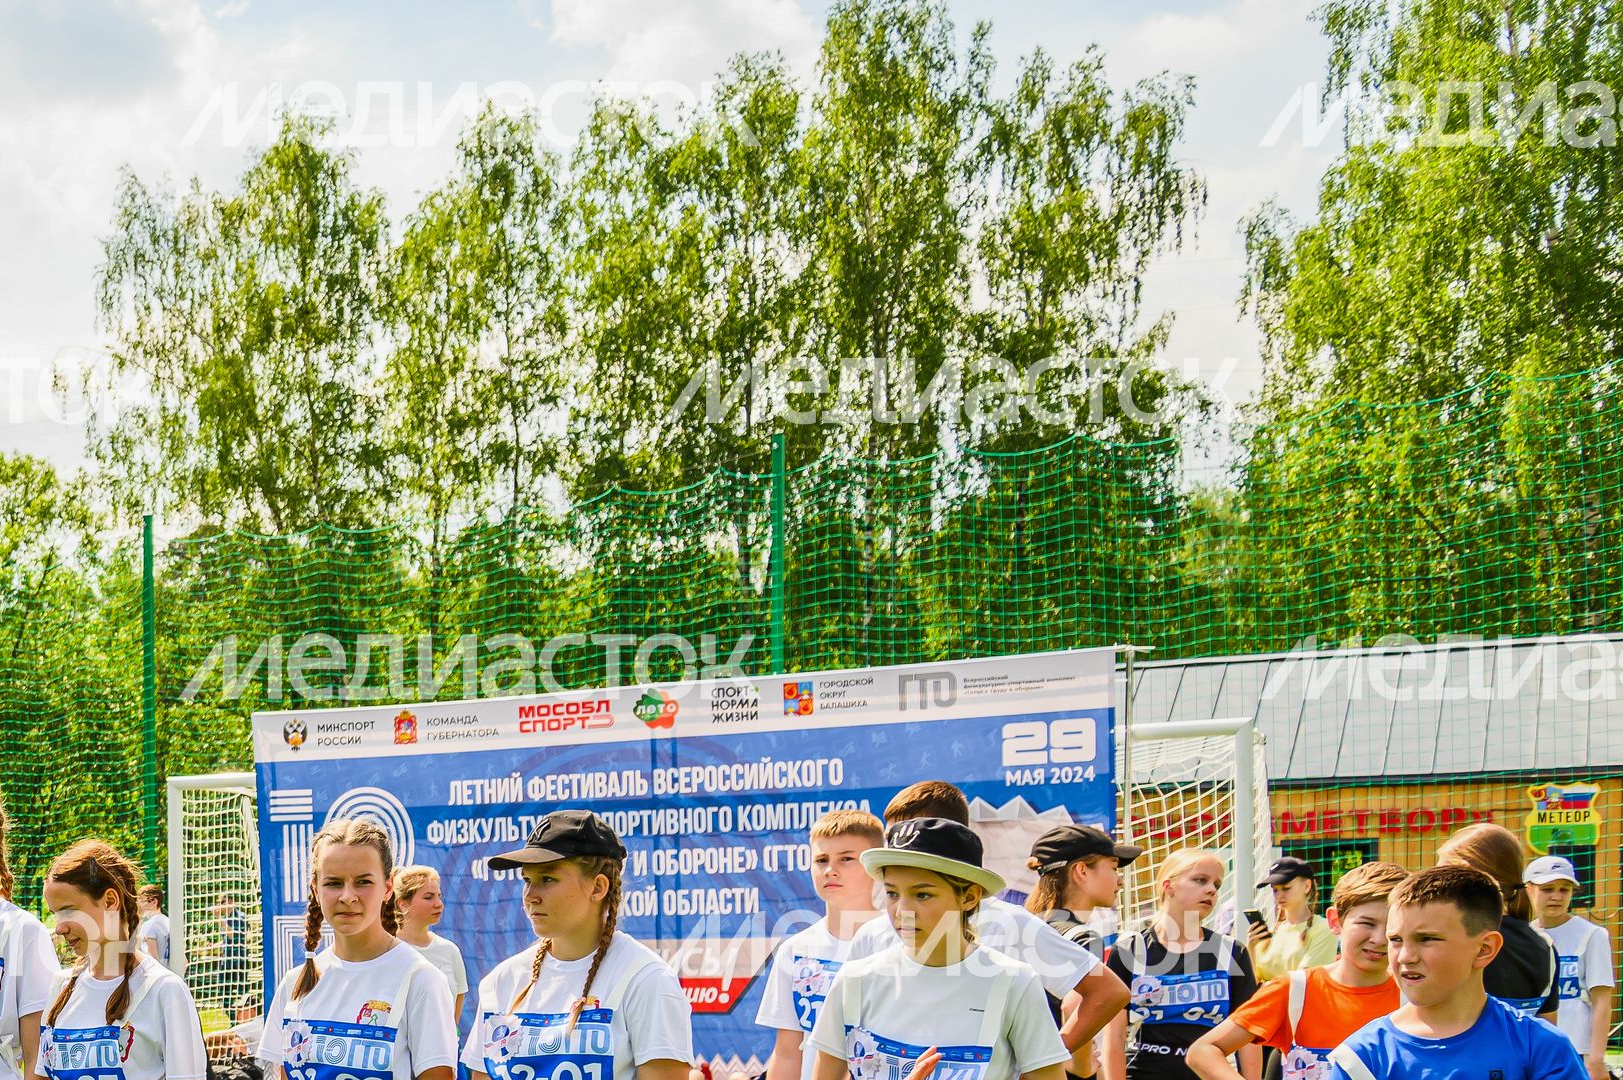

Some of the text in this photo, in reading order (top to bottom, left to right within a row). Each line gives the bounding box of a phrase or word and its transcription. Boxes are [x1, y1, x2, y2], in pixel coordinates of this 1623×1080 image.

[819, 676, 874, 689] ГОРОДСКОЙ
[819, 689, 847, 699] ОКРУГ
[712, 699, 758, 711] НОРМА
[819, 699, 868, 710] БАЛАШИХА
[427, 715, 479, 727] КОМАНДА
[712, 711, 759, 723] ЖИЗНИ
[317, 720, 375, 733] МИНСПОРТ
[519, 716, 591, 734] СПОРТ
[317, 735, 362, 746] РОССИИ
[427, 727, 499, 741] ГУБЕРНАТОРА
[1002, 717, 1096, 766] 29
[448, 757, 844, 806] ЛЕТНИЙ ФЕСТИВАЛЬ ВСЕРОССИЙСКОГО
[1005, 765, 1096, 787] МАЯ 2024
[1537, 810, 1591, 824] МЕТЕОР
[633, 856, 648, 877] И
[651, 847, 759, 876] ОБОРОНЕ»
[663, 887, 759, 917] ОБЛАСТИ
